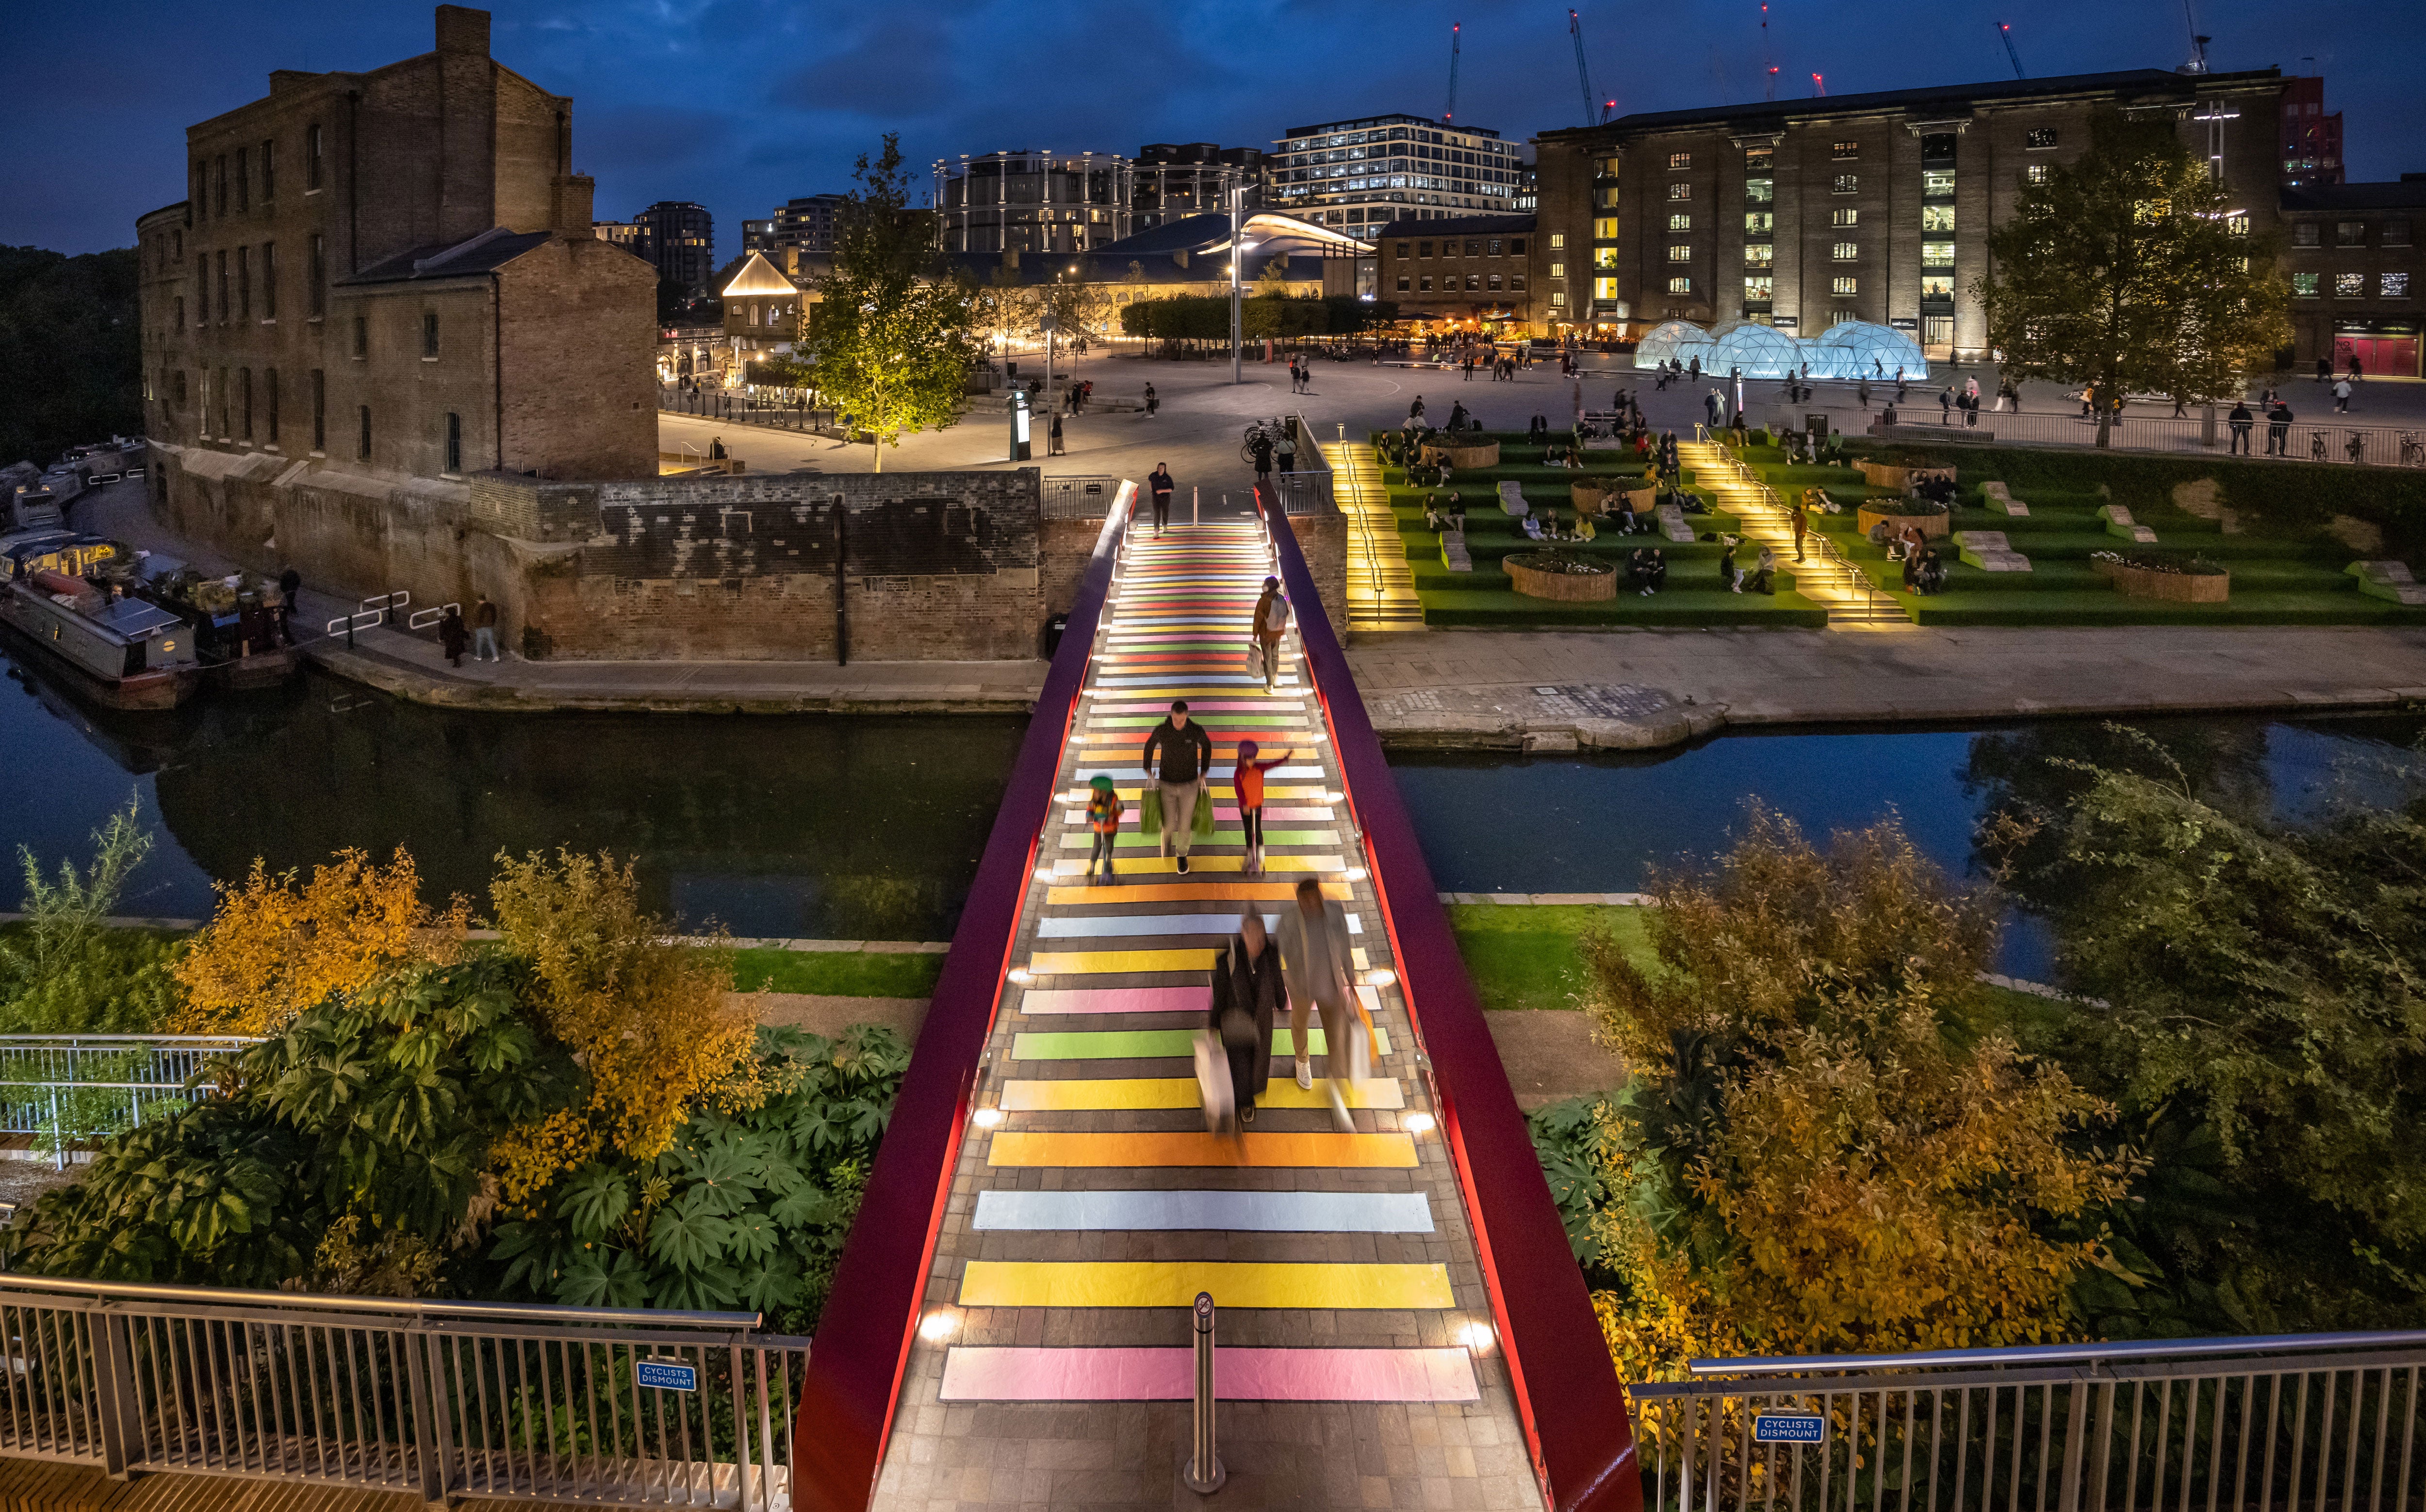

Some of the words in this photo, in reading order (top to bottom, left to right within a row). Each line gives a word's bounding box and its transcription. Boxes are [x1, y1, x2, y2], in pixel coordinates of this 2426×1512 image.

[644, 1366, 687, 1378] CYCLISTS
[642, 1375, 691, 1385] DISMOUNT
[1765, 1420, 1814, 1429] CYCLISTS
[1760, 1429, 1818, 1437] DISMOUNT
